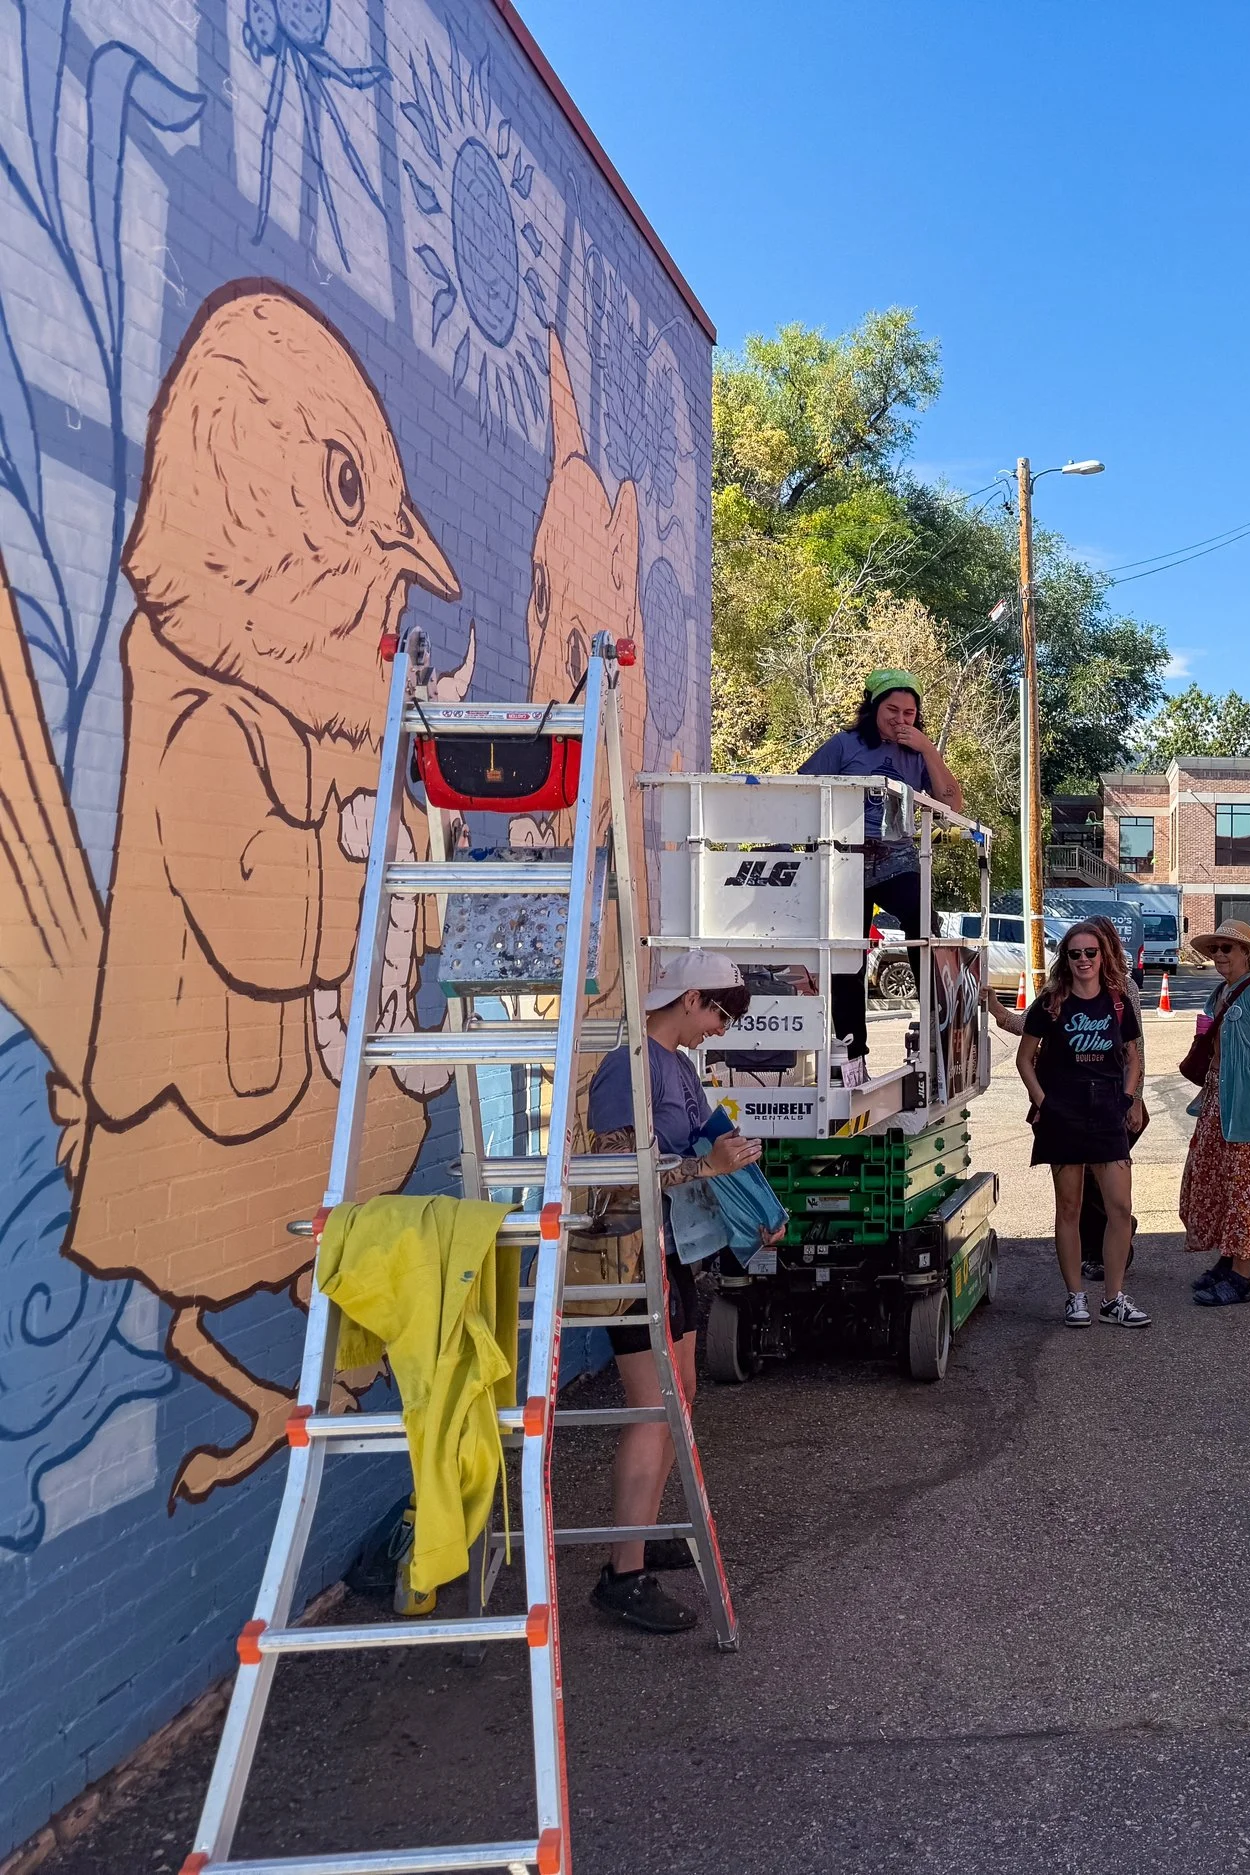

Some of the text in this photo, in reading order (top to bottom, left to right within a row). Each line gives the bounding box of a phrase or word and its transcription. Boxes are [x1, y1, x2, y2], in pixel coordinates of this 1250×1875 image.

[724, 861, 801, 886] JLG
[725, 1015, 804, 1032] 435615
[1064, 1012, 1112, 1032] Street
[1069, 1031, 1113, 1053] Wise
[1075, 1054, 1105, 1062] BOULDER
[745, 1103, 814, 1115] SUNBELT
